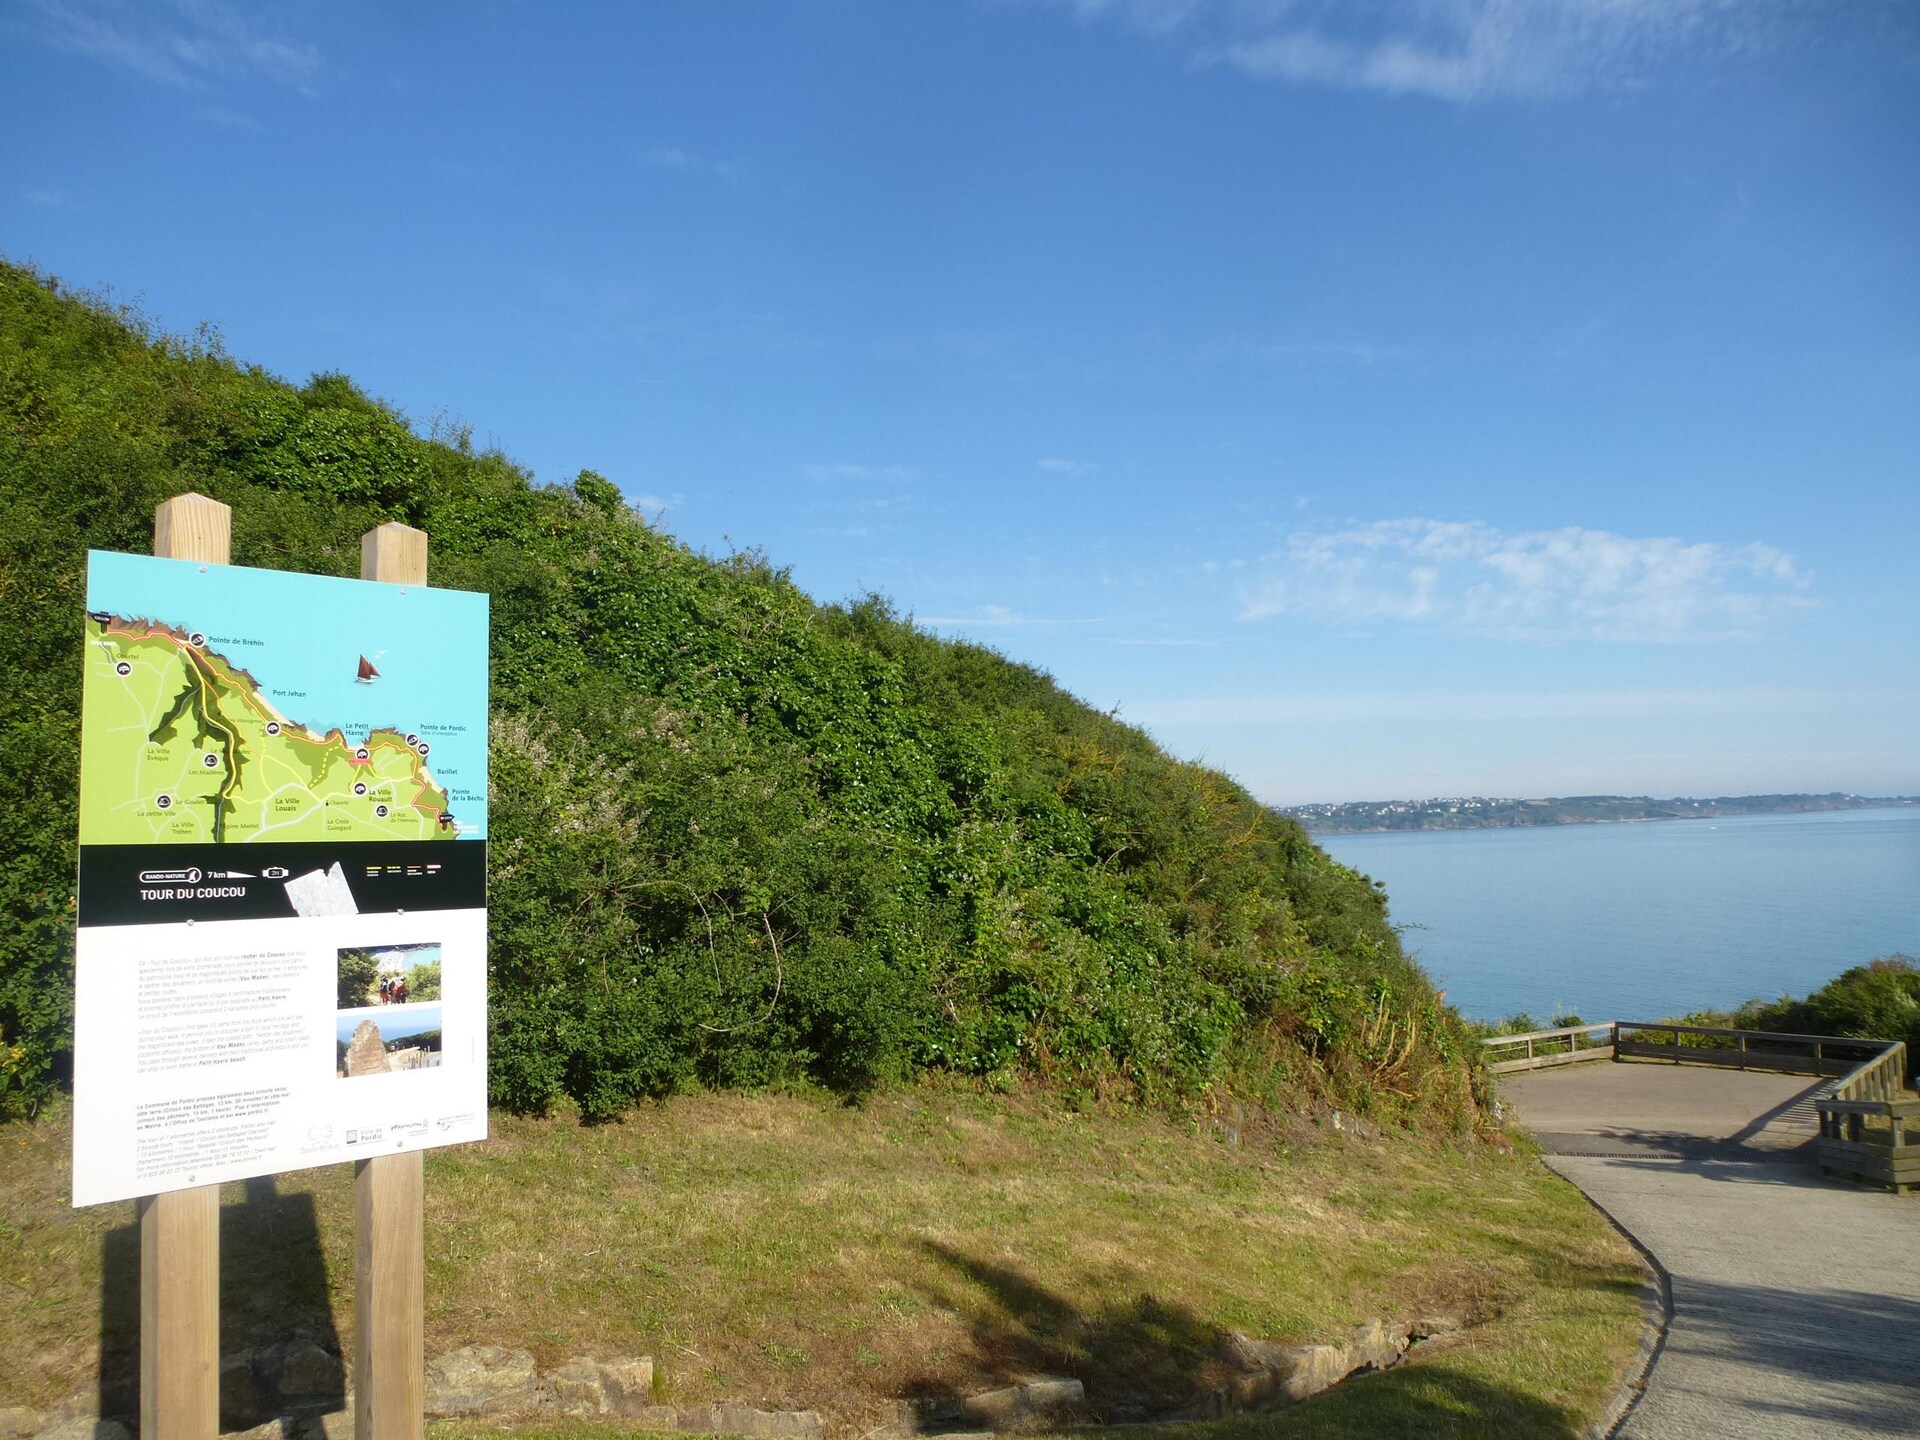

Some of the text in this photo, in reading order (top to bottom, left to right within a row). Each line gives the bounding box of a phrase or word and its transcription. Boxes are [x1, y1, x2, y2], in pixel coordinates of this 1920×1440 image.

[140, 887, 246, 900] TOUR DU COUCOU
